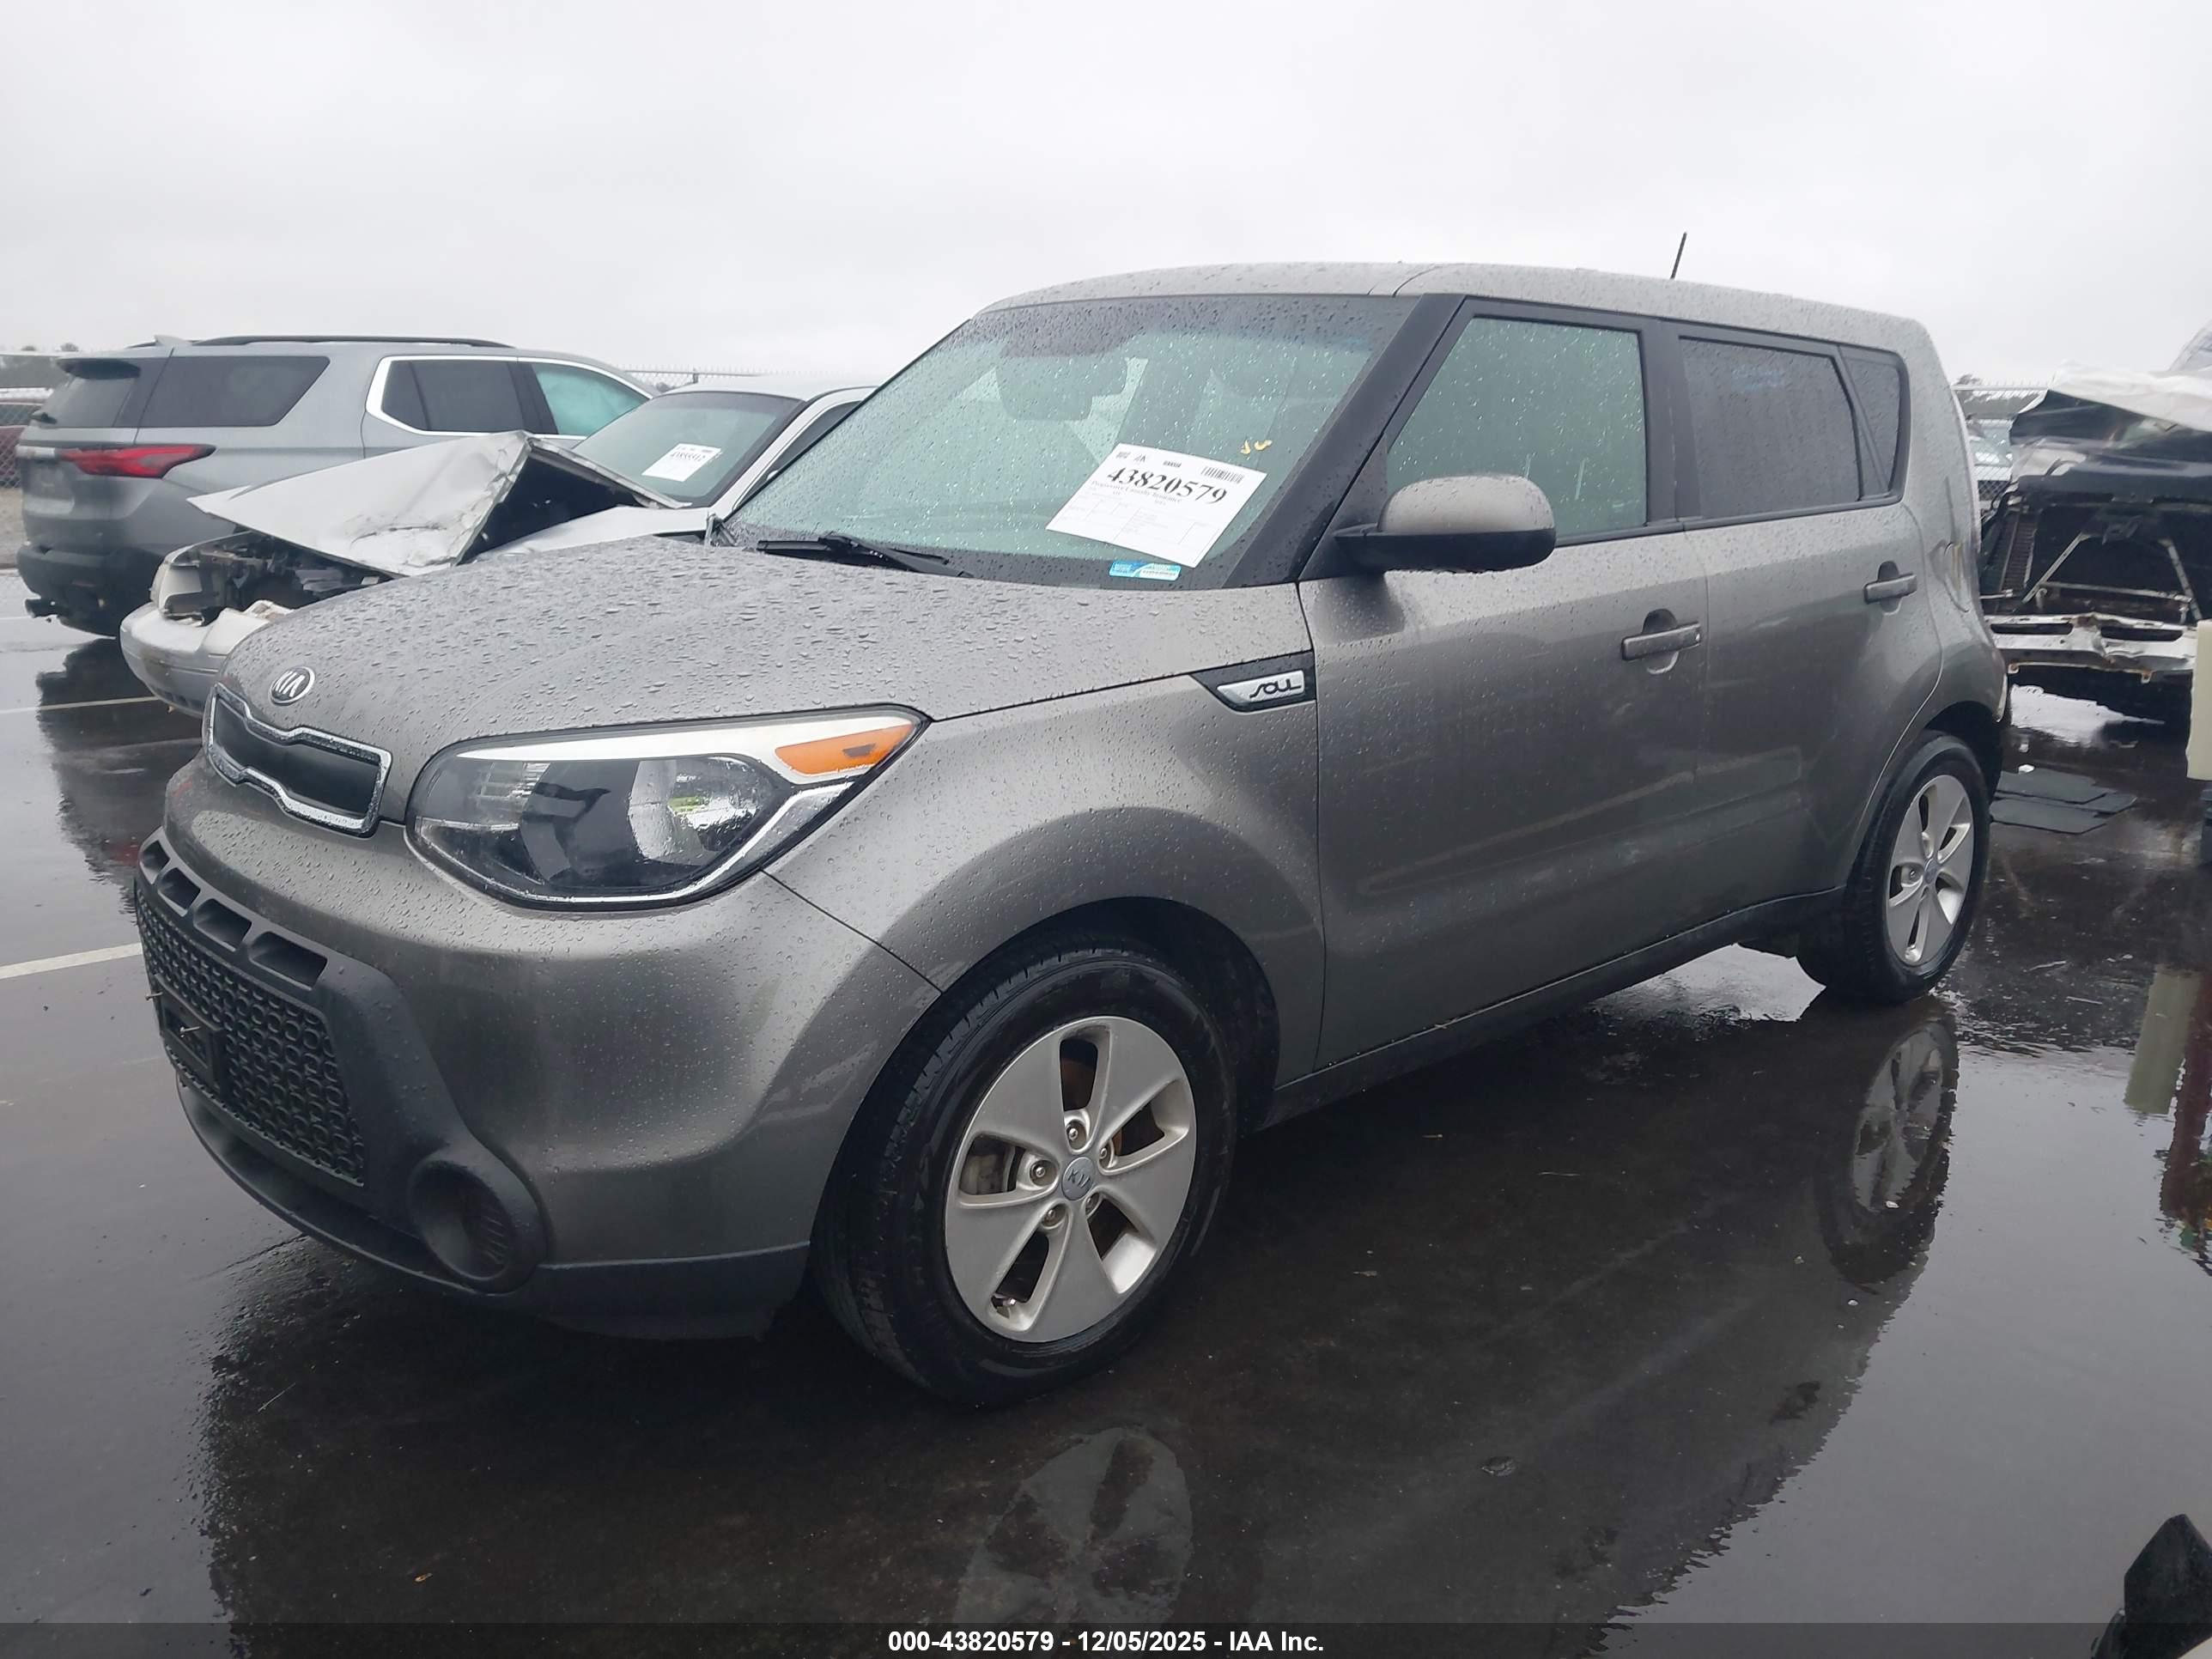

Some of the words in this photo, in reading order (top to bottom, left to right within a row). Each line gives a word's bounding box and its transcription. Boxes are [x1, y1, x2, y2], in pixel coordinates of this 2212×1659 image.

[1107, 467, 1227, 504] 43820579
[271, 670, 307, 698] KIA
[1067, 1168, 1091, 1192] KIA
